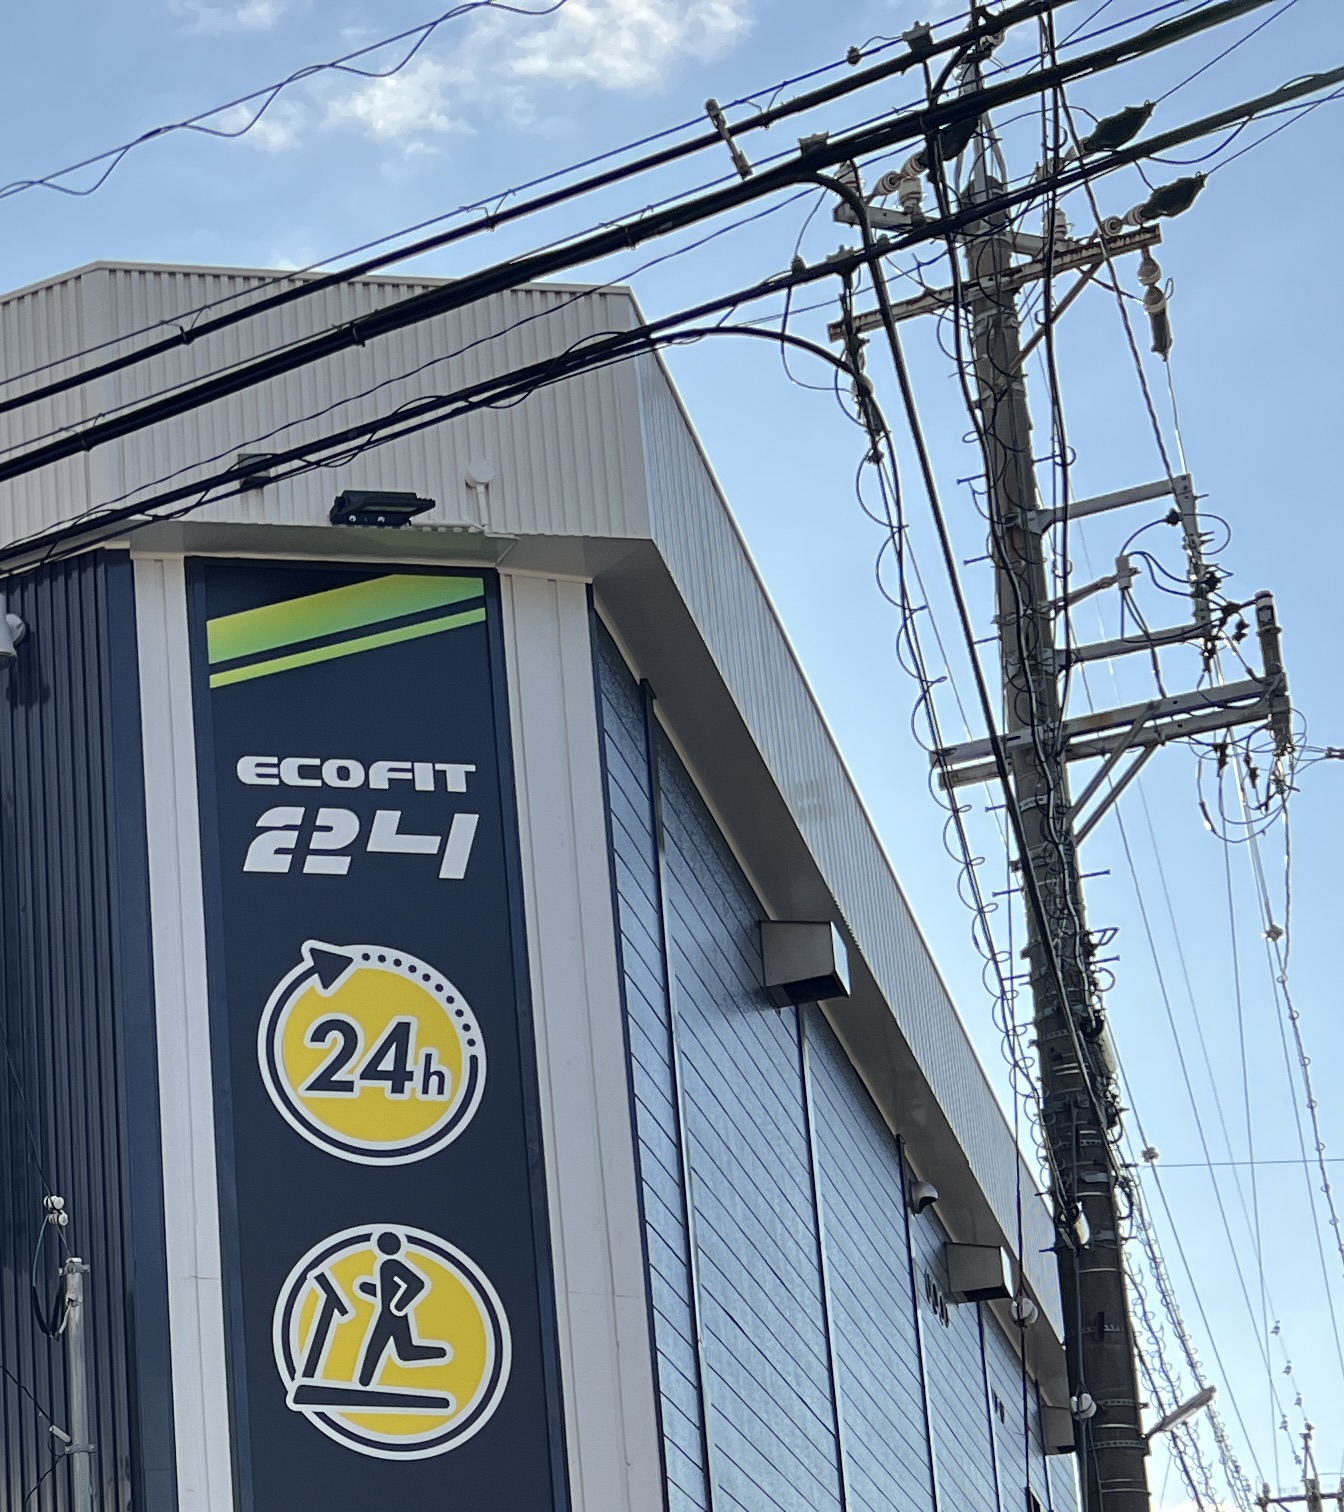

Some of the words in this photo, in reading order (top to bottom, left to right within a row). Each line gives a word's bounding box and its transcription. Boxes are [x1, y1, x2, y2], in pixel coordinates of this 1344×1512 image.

[236, 755, 477, 793] ECOFIT
[242, 805, 480, 880] 24
[302, 1016, 447, 1098] 24h
